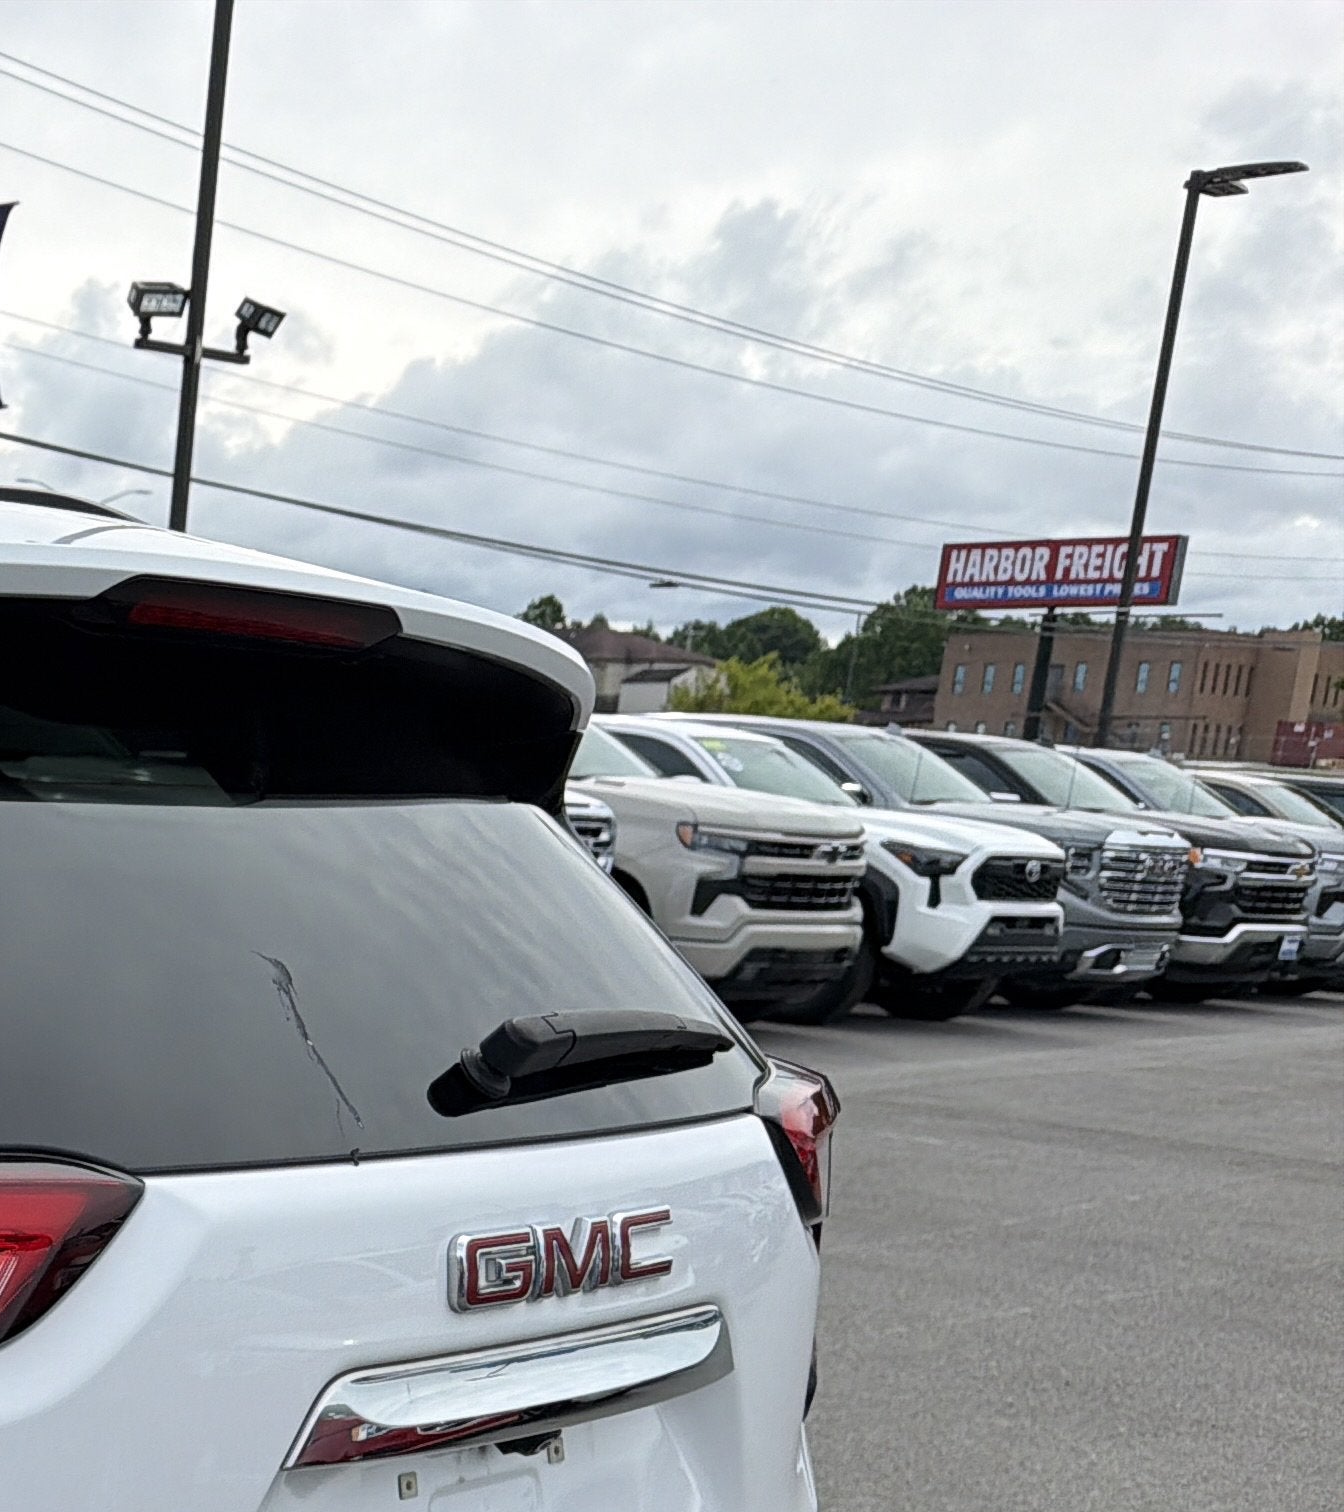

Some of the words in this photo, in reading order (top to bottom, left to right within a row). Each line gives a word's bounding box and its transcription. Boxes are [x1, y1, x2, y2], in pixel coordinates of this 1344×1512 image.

[946, 546, 1050, 583] HARBOR
[1055, 542, 1168, 580] FREIGHT
[954, 586, 1006, 600] QUALITY
[1007, 584, 1046, 598] TOOLS
[447, 1204, 673, 1313] GMC
